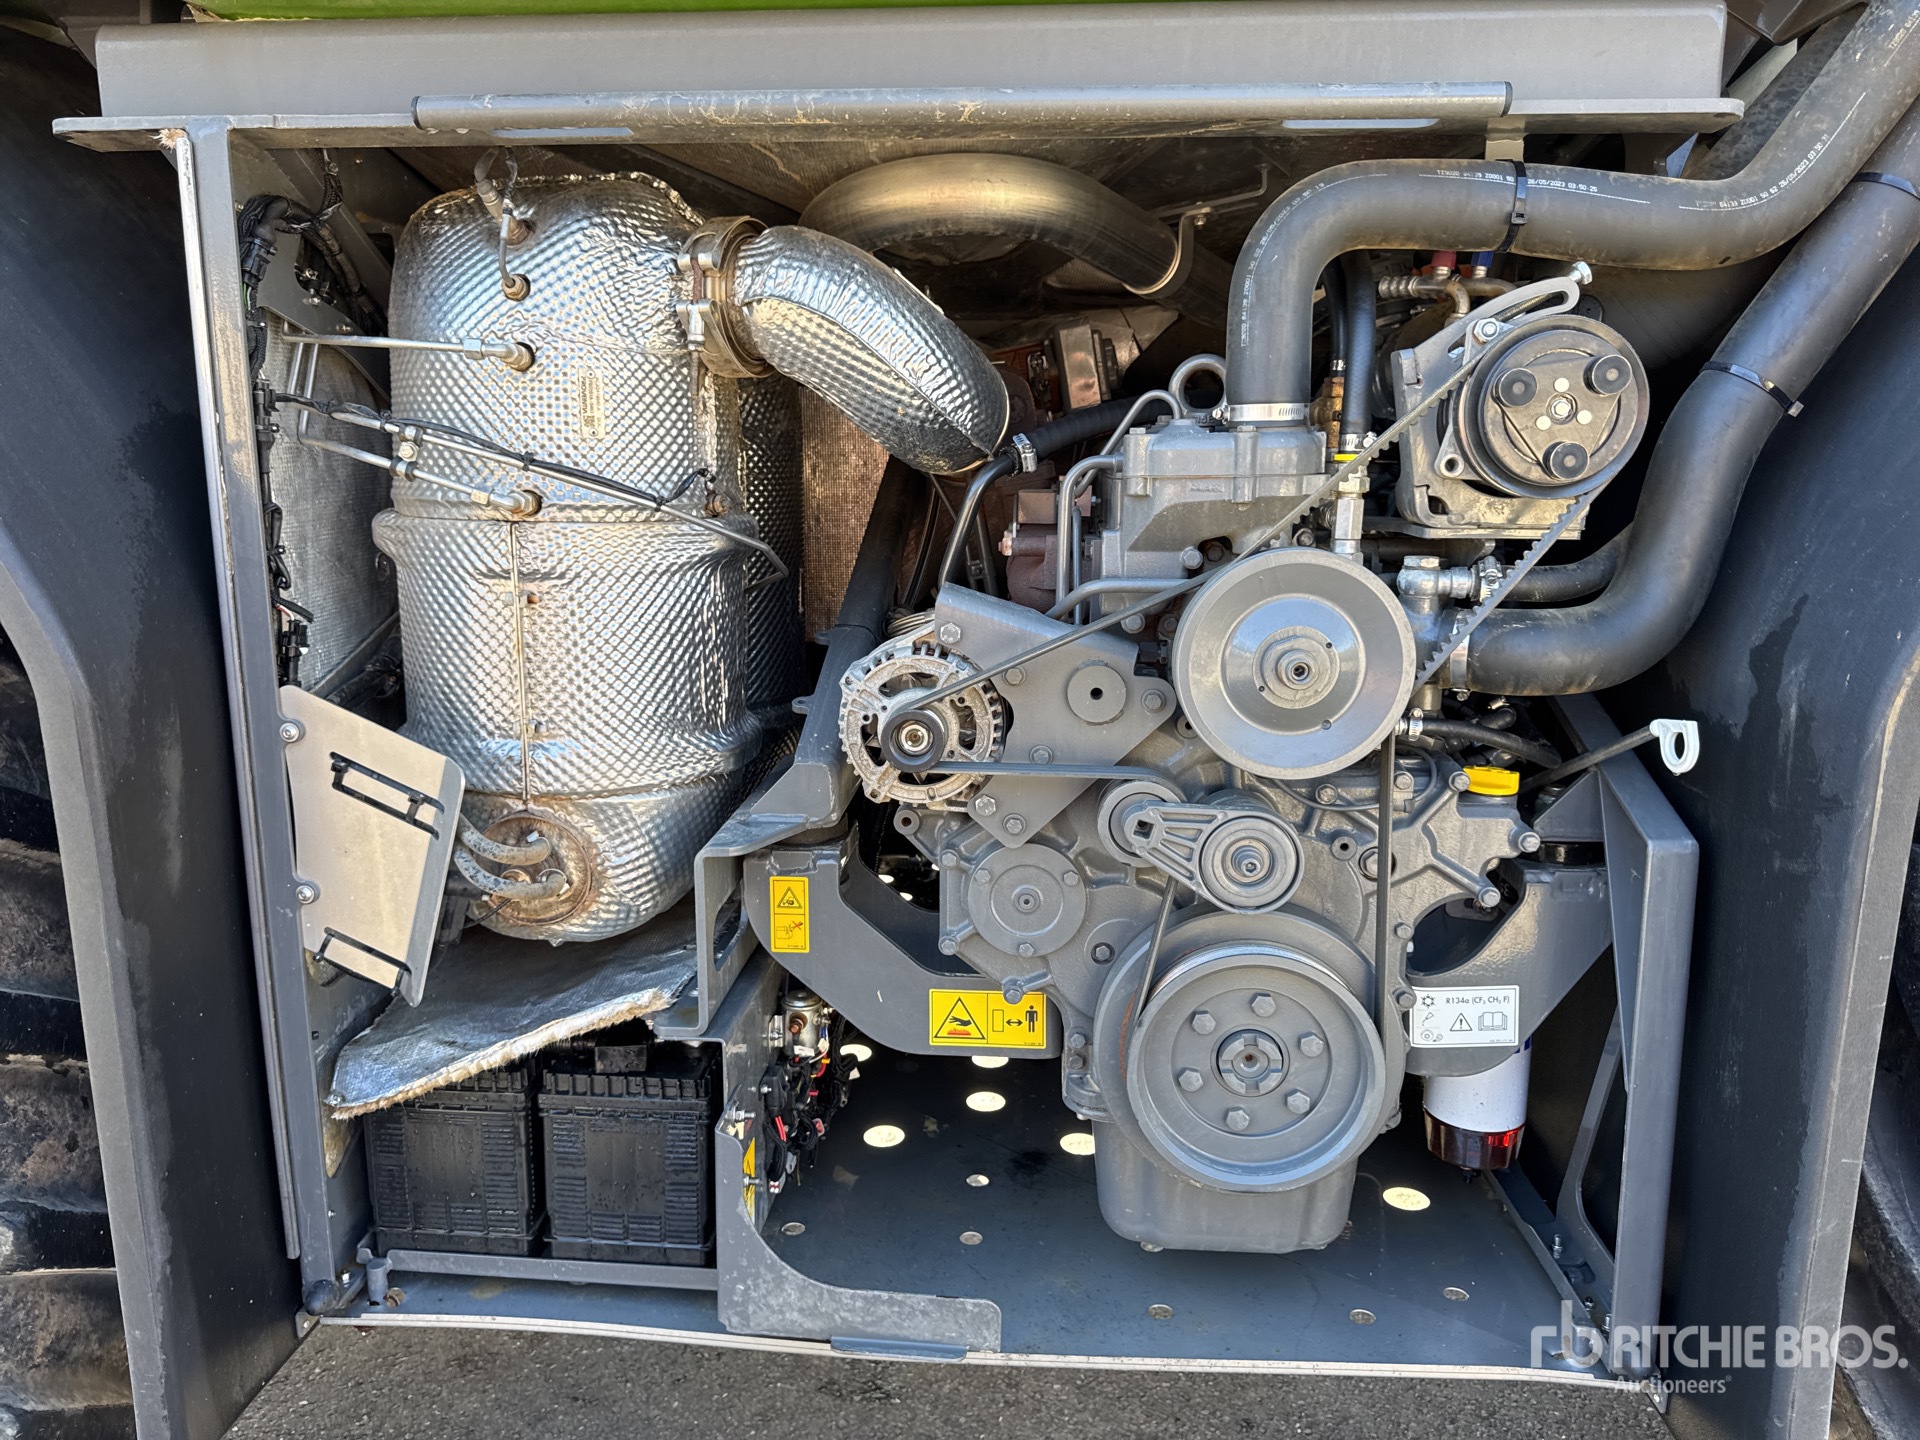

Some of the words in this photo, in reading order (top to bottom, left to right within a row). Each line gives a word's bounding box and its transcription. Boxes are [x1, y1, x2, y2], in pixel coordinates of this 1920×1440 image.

[1778, 159, 1810, 188] 26/05/2023
[1527, 178, 1565, 188] 26/05/2023
[1503, 996, 1510, 1004] F)
